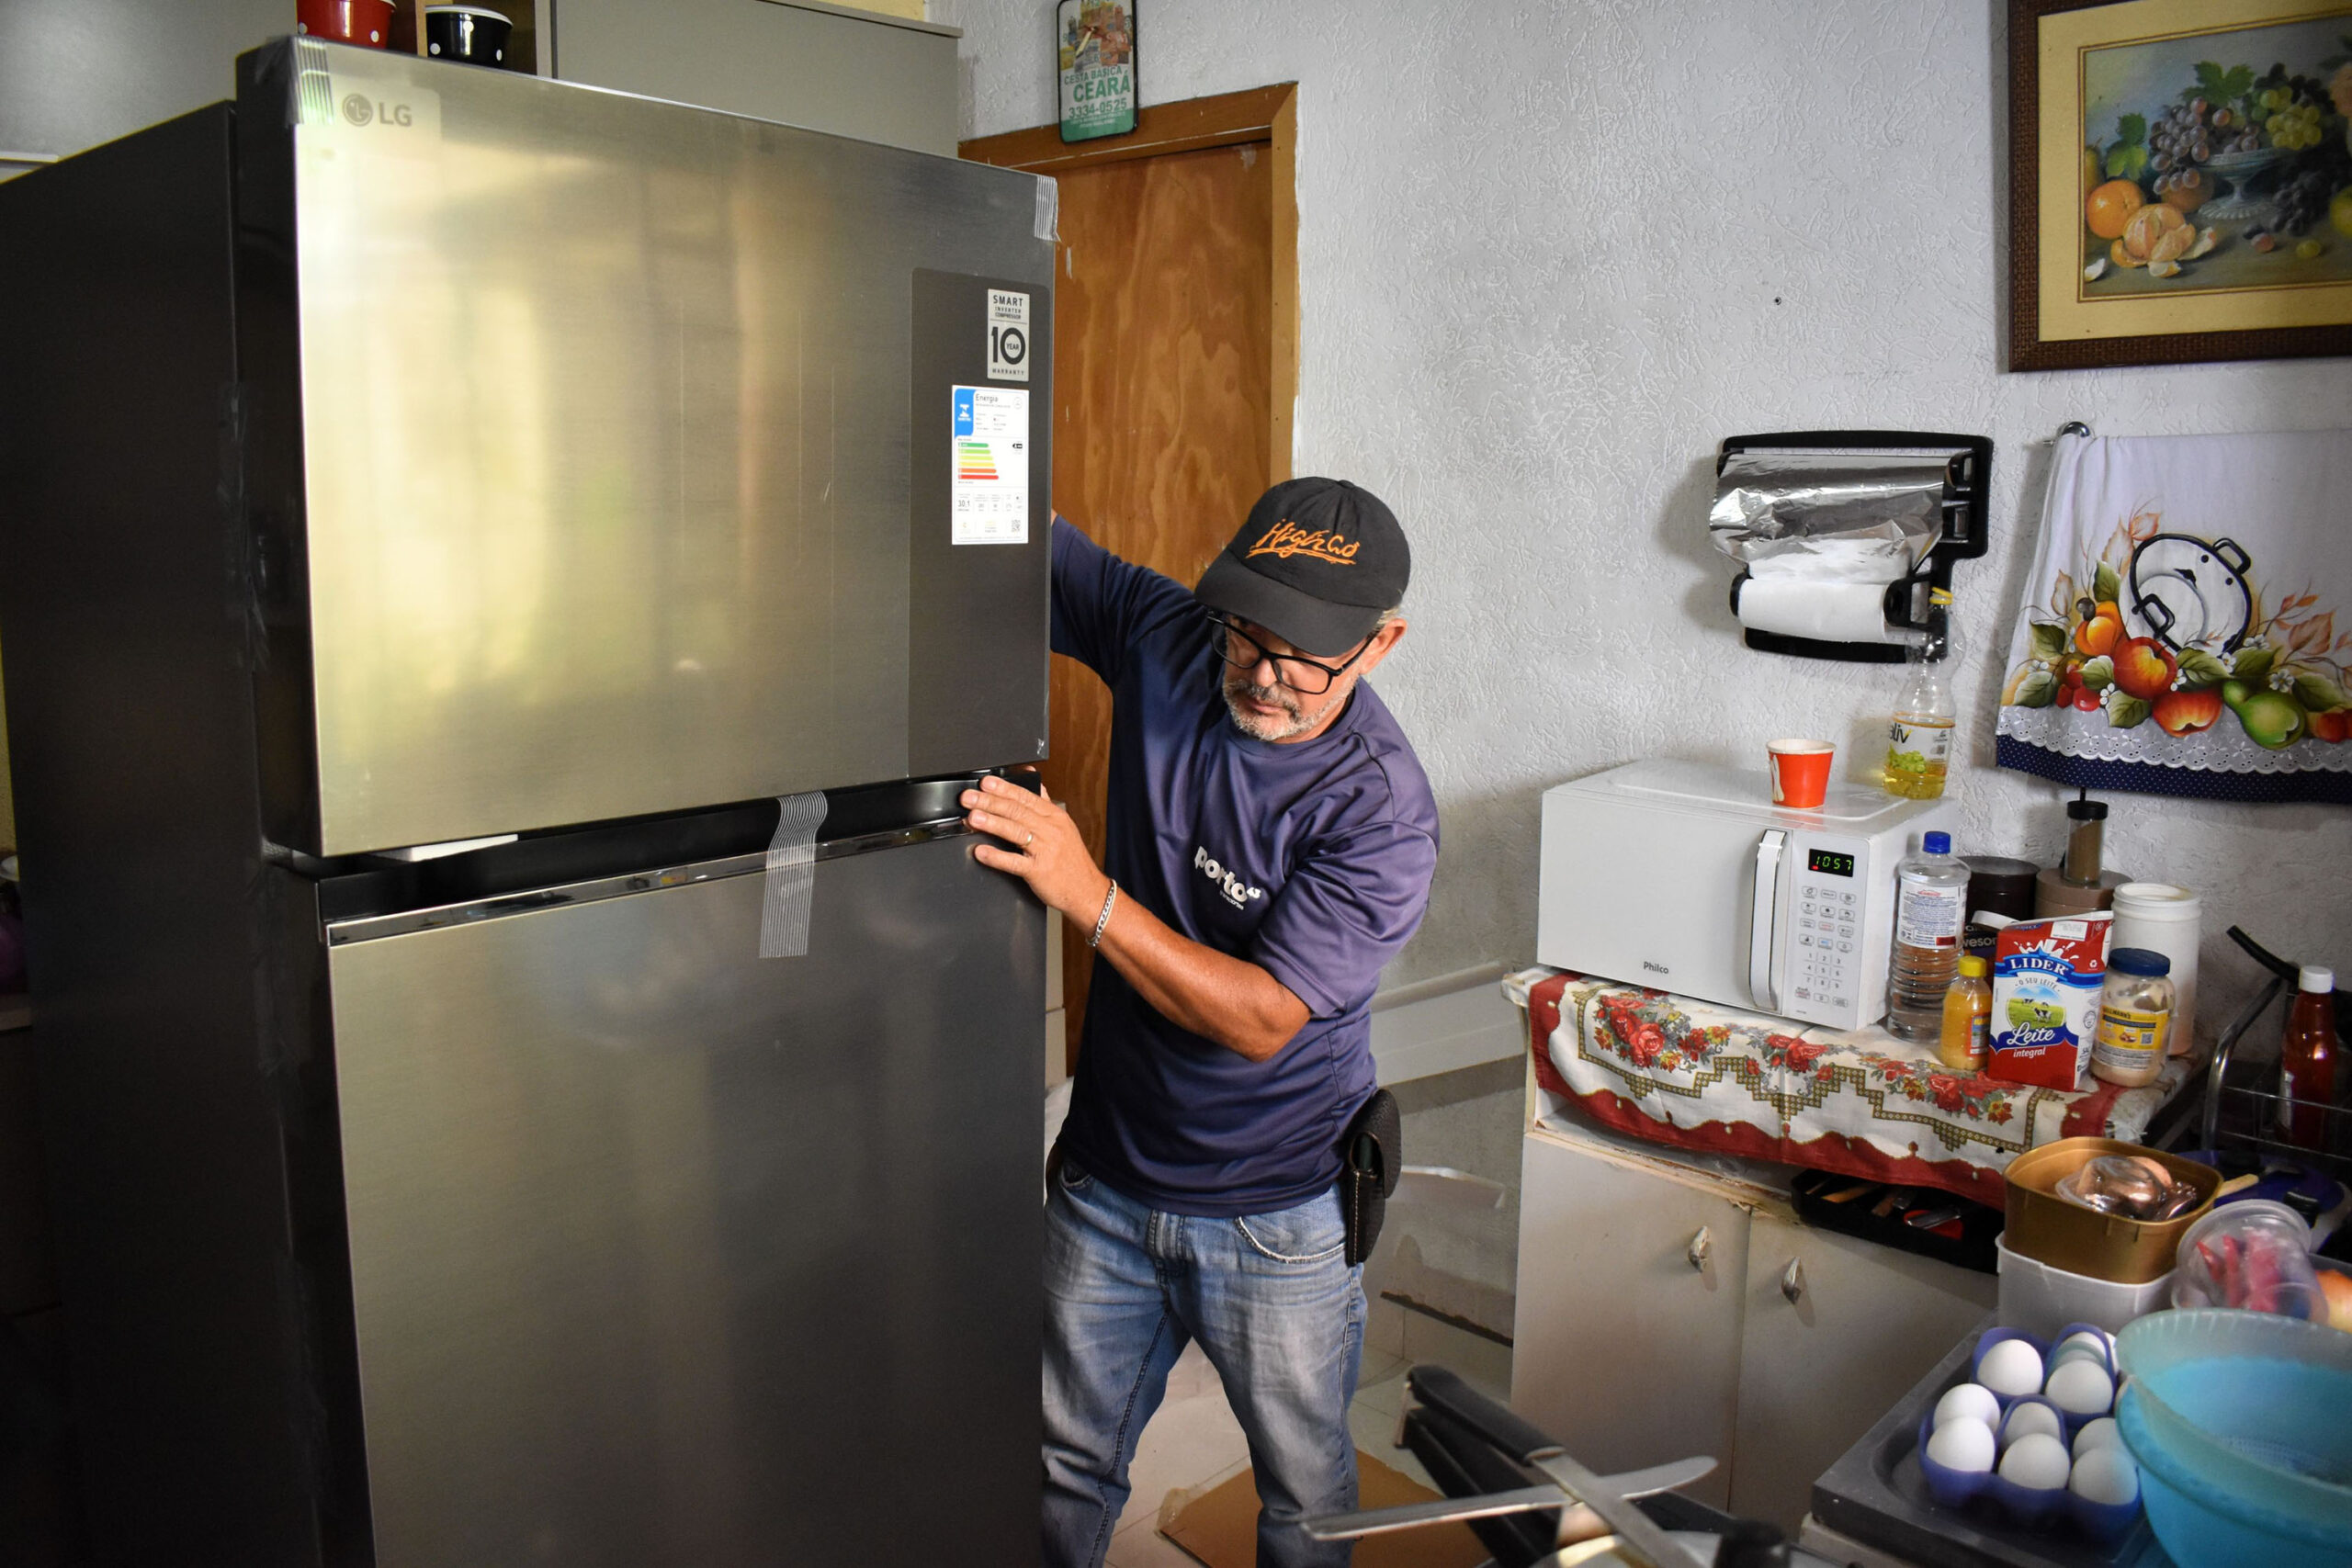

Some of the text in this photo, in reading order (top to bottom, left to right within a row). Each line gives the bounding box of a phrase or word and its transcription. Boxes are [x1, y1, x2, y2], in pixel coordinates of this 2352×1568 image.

[1064, 71, 1090, 85] CESTA
[1073, 70, 1131, 103] CEARÁ
[379, 102, 413, 127] LG
[1069, 97, 1127, 119] 3334-0525
[993, 295, 1023, 307] SMART
[994, 306, 1022, 314] INVERTER
[991, 326, 1026, 365] 10
[976, 393, 999, 404] Energia
[1194, 846, 1248, 902] porto
[1644, 961, 1669, 974] Philco
[2010, 957, 2066, 976] LIDER
[2040, 978, 2057, 989] LEITE
[2007, 1021, 2055, 1045] Leite
[2013, 1047, 2046, 1058] integral
